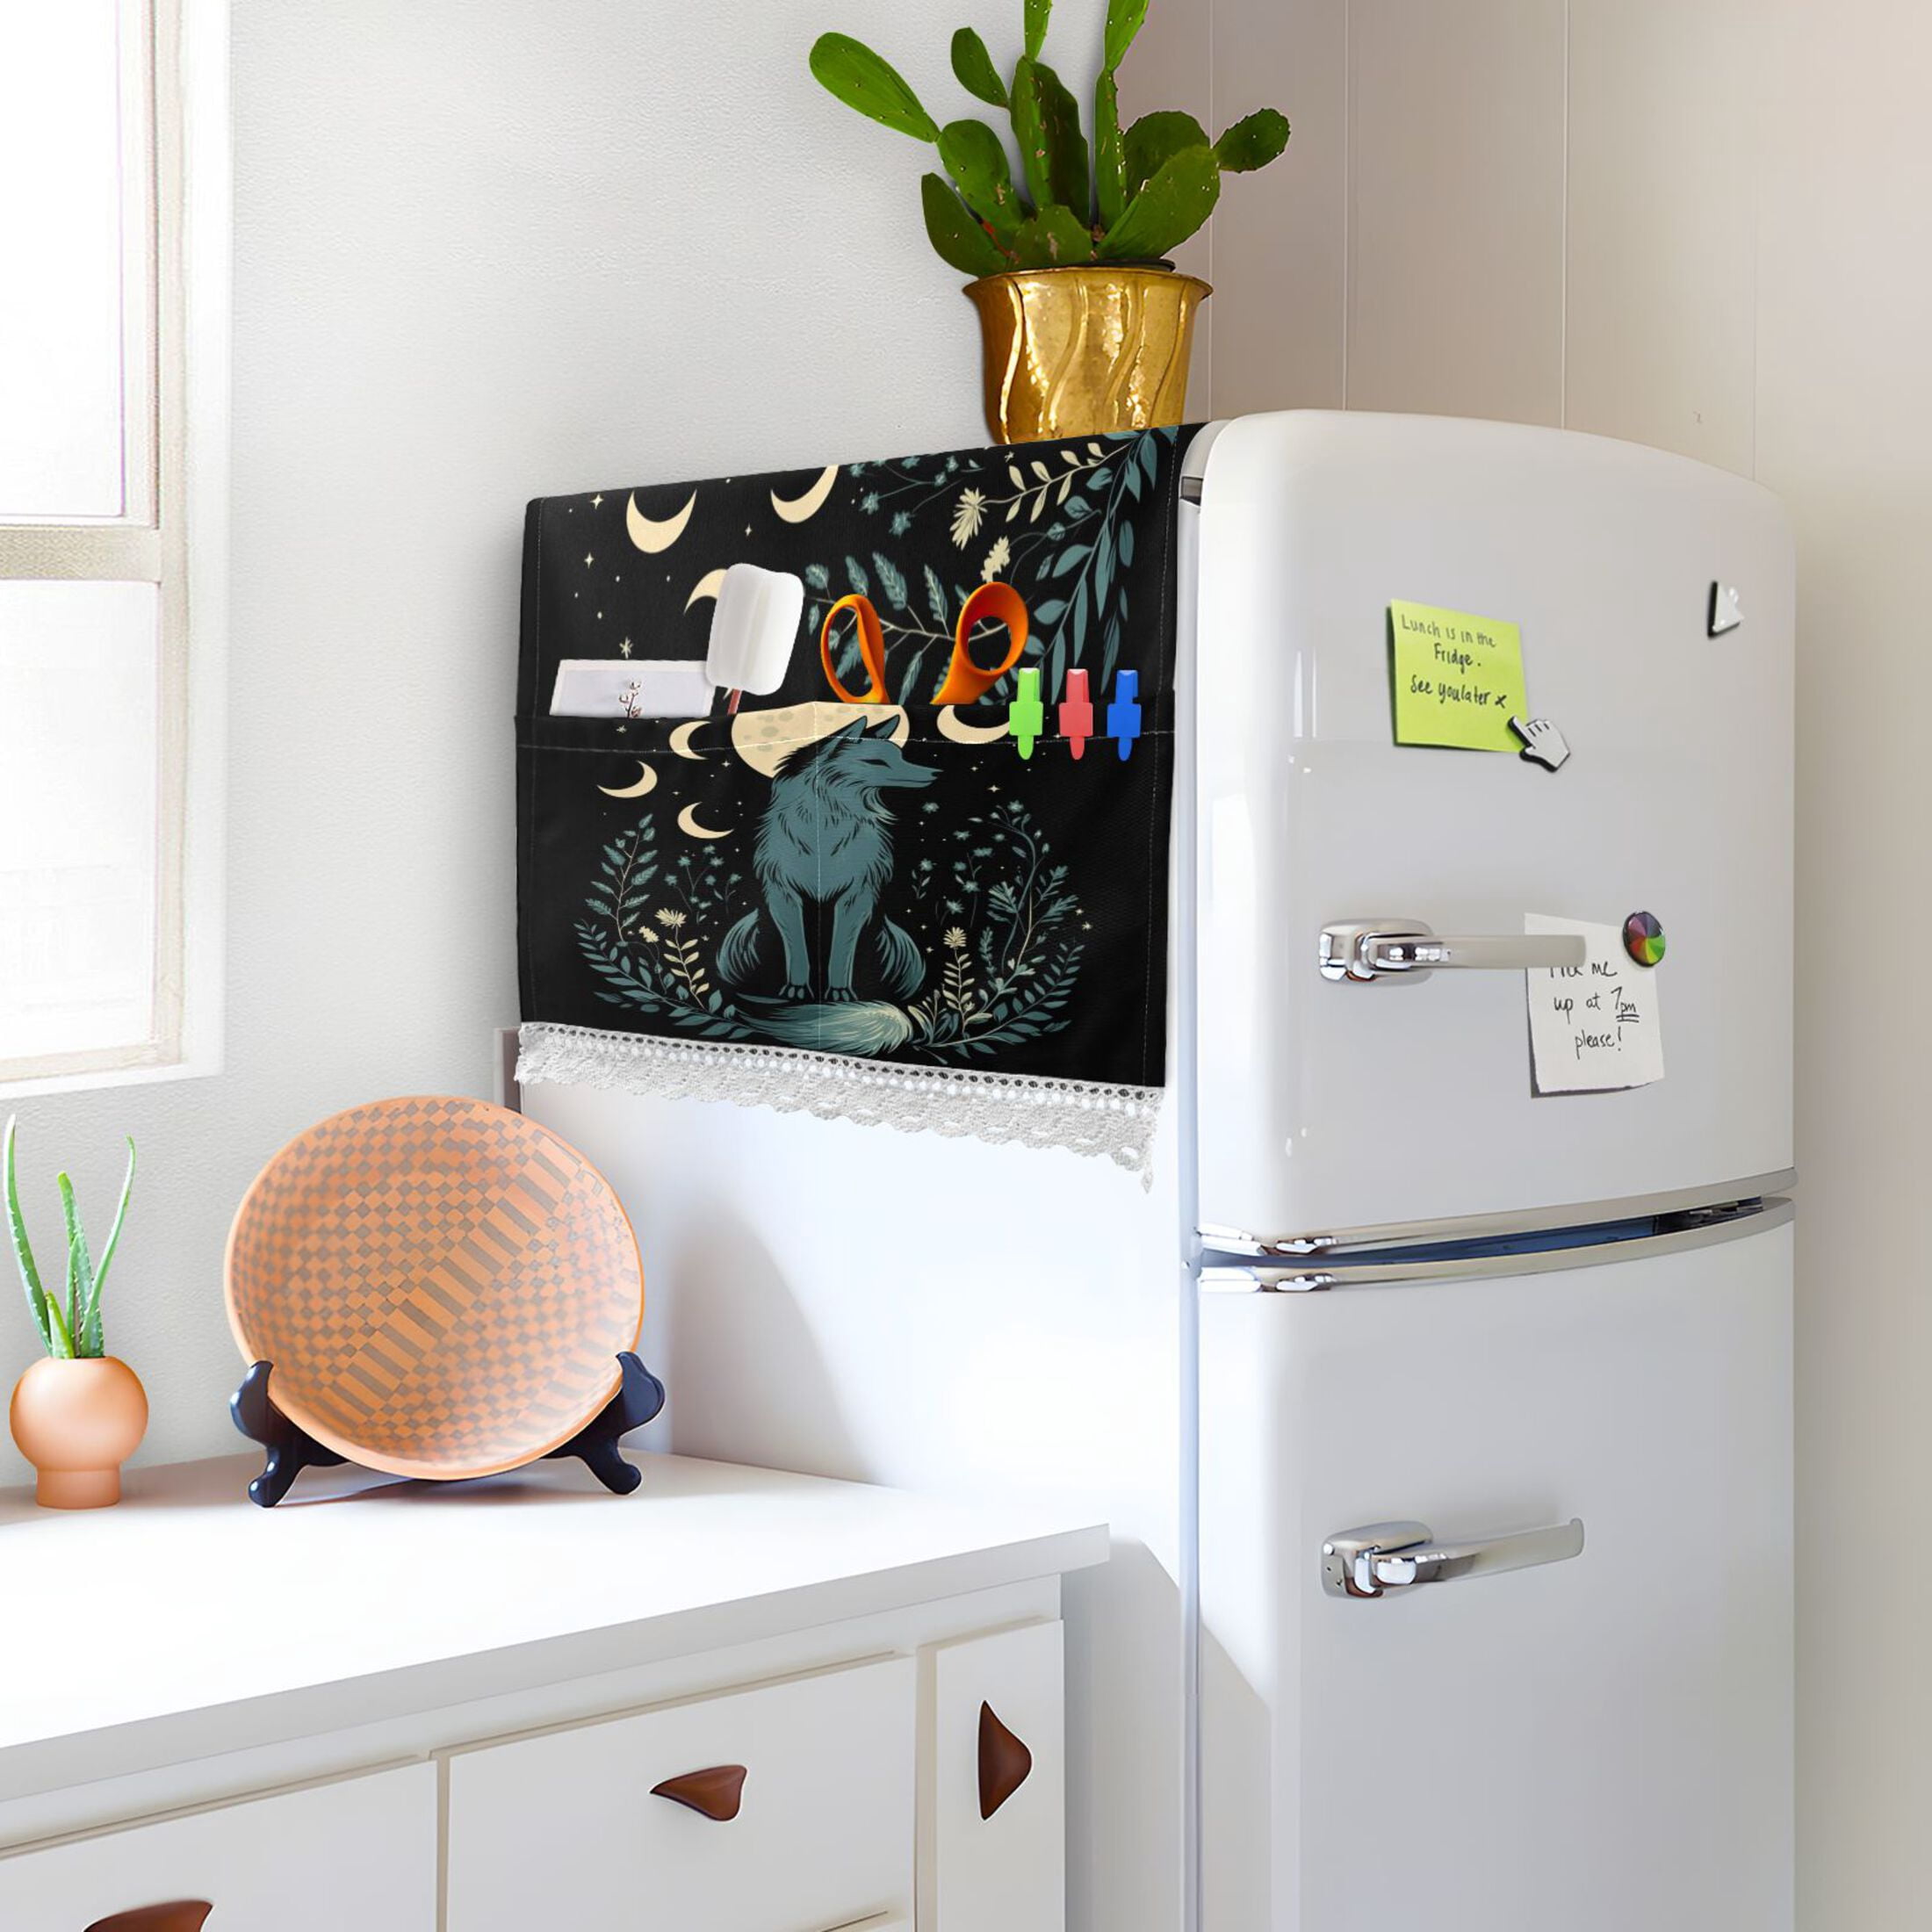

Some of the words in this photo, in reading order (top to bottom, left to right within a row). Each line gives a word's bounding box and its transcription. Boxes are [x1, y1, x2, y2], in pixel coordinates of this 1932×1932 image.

[1401, 614, 1440, 638] Lunch
[1445, 627, 1456, 640] is
[1460, 631, 1474, 644] in
[1476, 631, 1496, 648] the
[1410, 674, 1433, 695] See
[1554, 996, 1574, 1025] up
[1585, 991, 1601, 1011] at
[1575, 1026, 1622, 1060] please!
